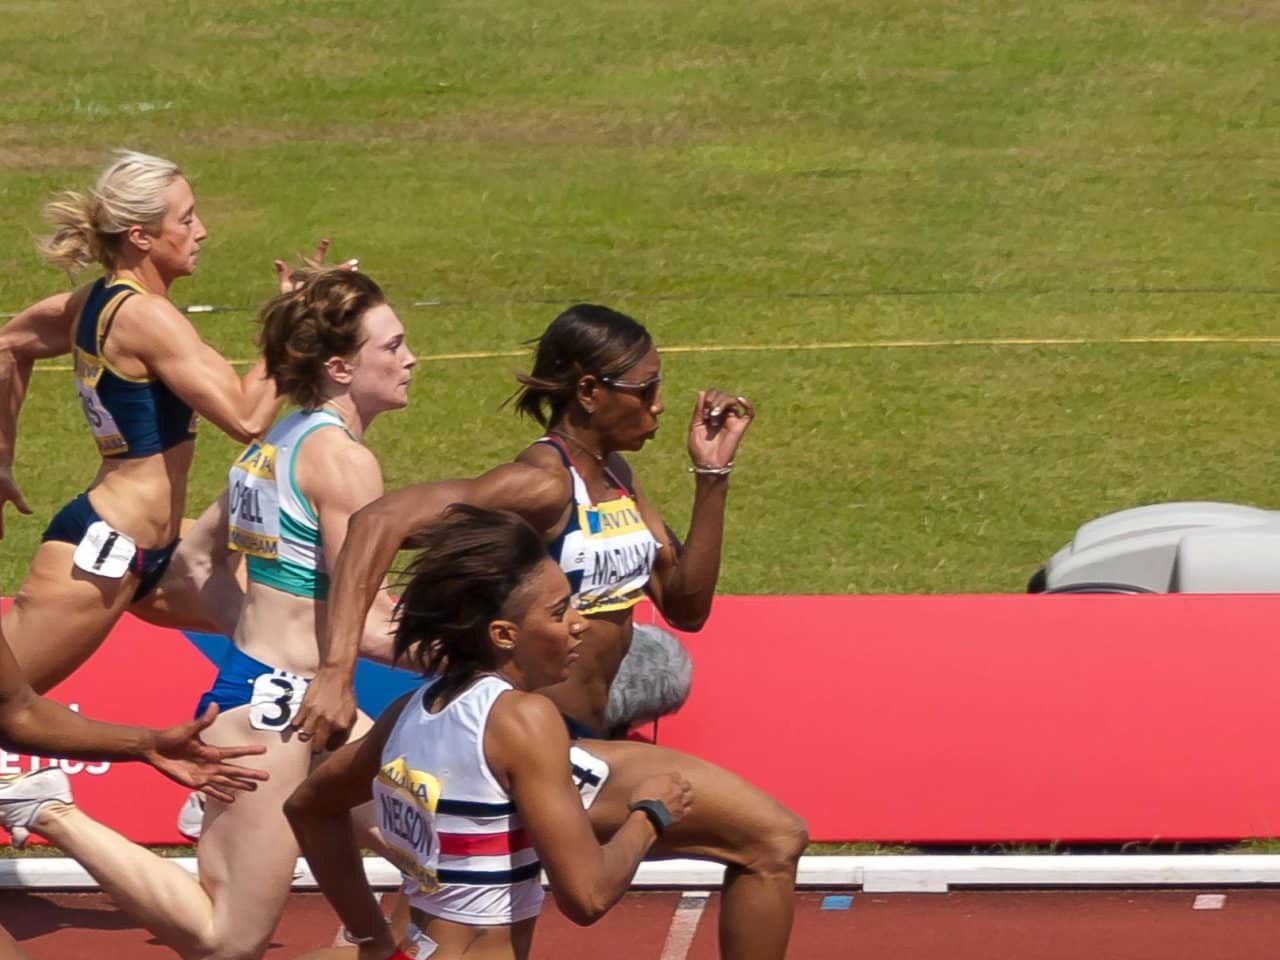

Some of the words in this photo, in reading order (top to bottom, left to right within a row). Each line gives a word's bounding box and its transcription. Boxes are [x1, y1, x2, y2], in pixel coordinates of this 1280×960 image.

[93, 531, 119, 571] 1
[261, 678, 294, 727] 3
[380, 793, 433, 857] NELSON
